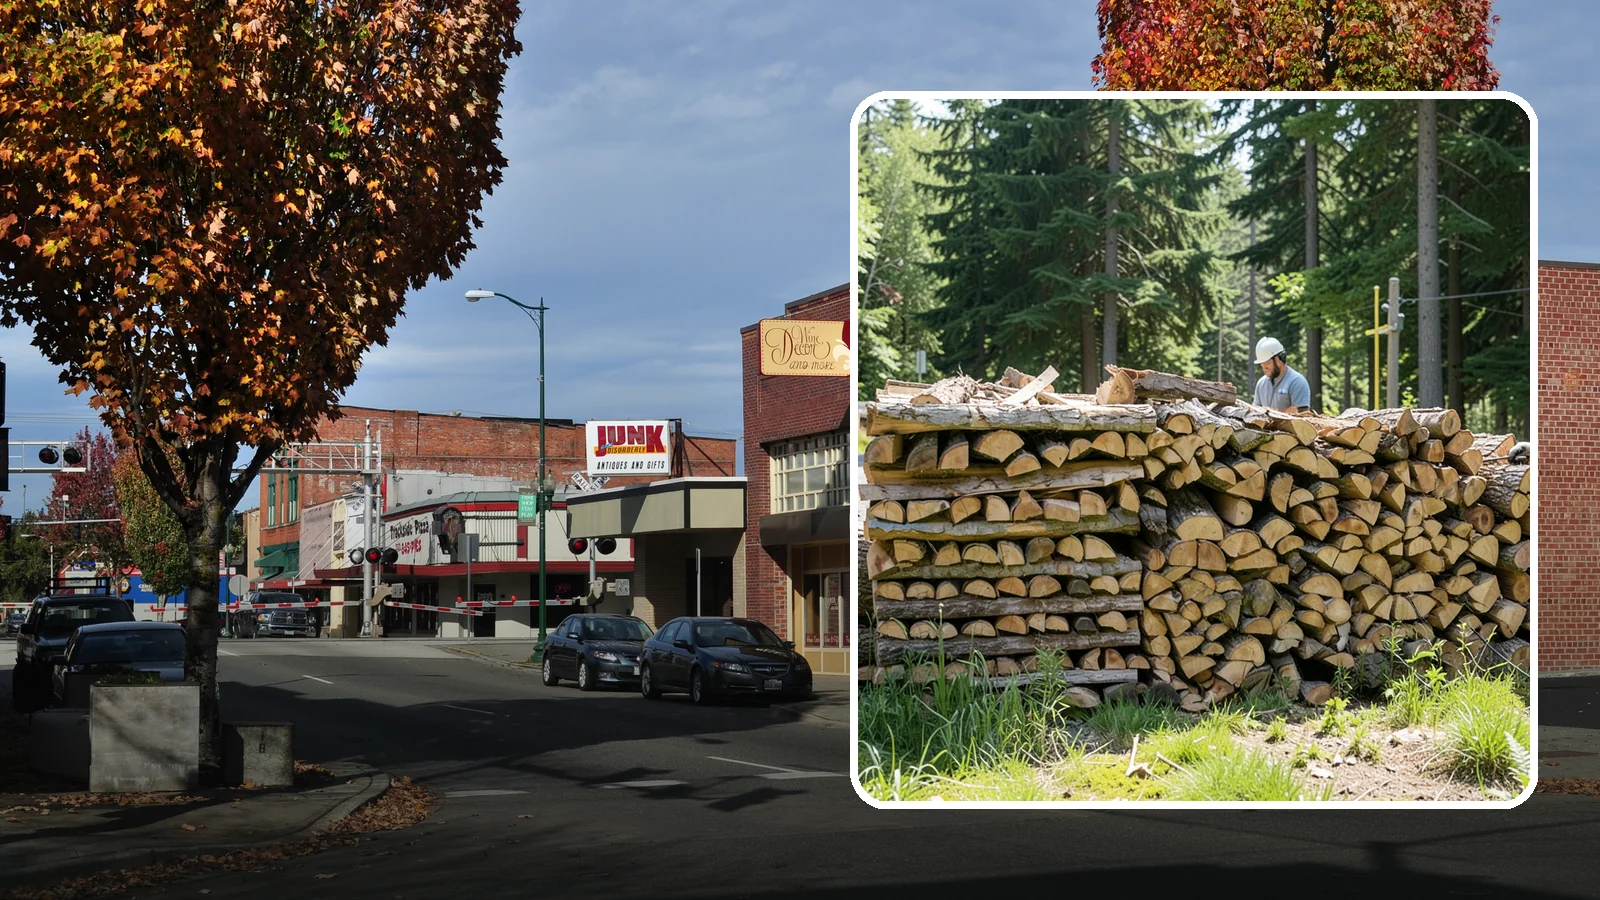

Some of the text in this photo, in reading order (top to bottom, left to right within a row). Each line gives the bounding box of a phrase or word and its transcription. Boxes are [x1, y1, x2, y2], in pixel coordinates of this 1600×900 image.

[596, 425, 664, 457] JUNK
[607, 446, 645, 454] DISORDERLY
[597, 460, 665, 470] ANTIQUES AND GIFTS
[415, 519, 429, 535] Pizza
